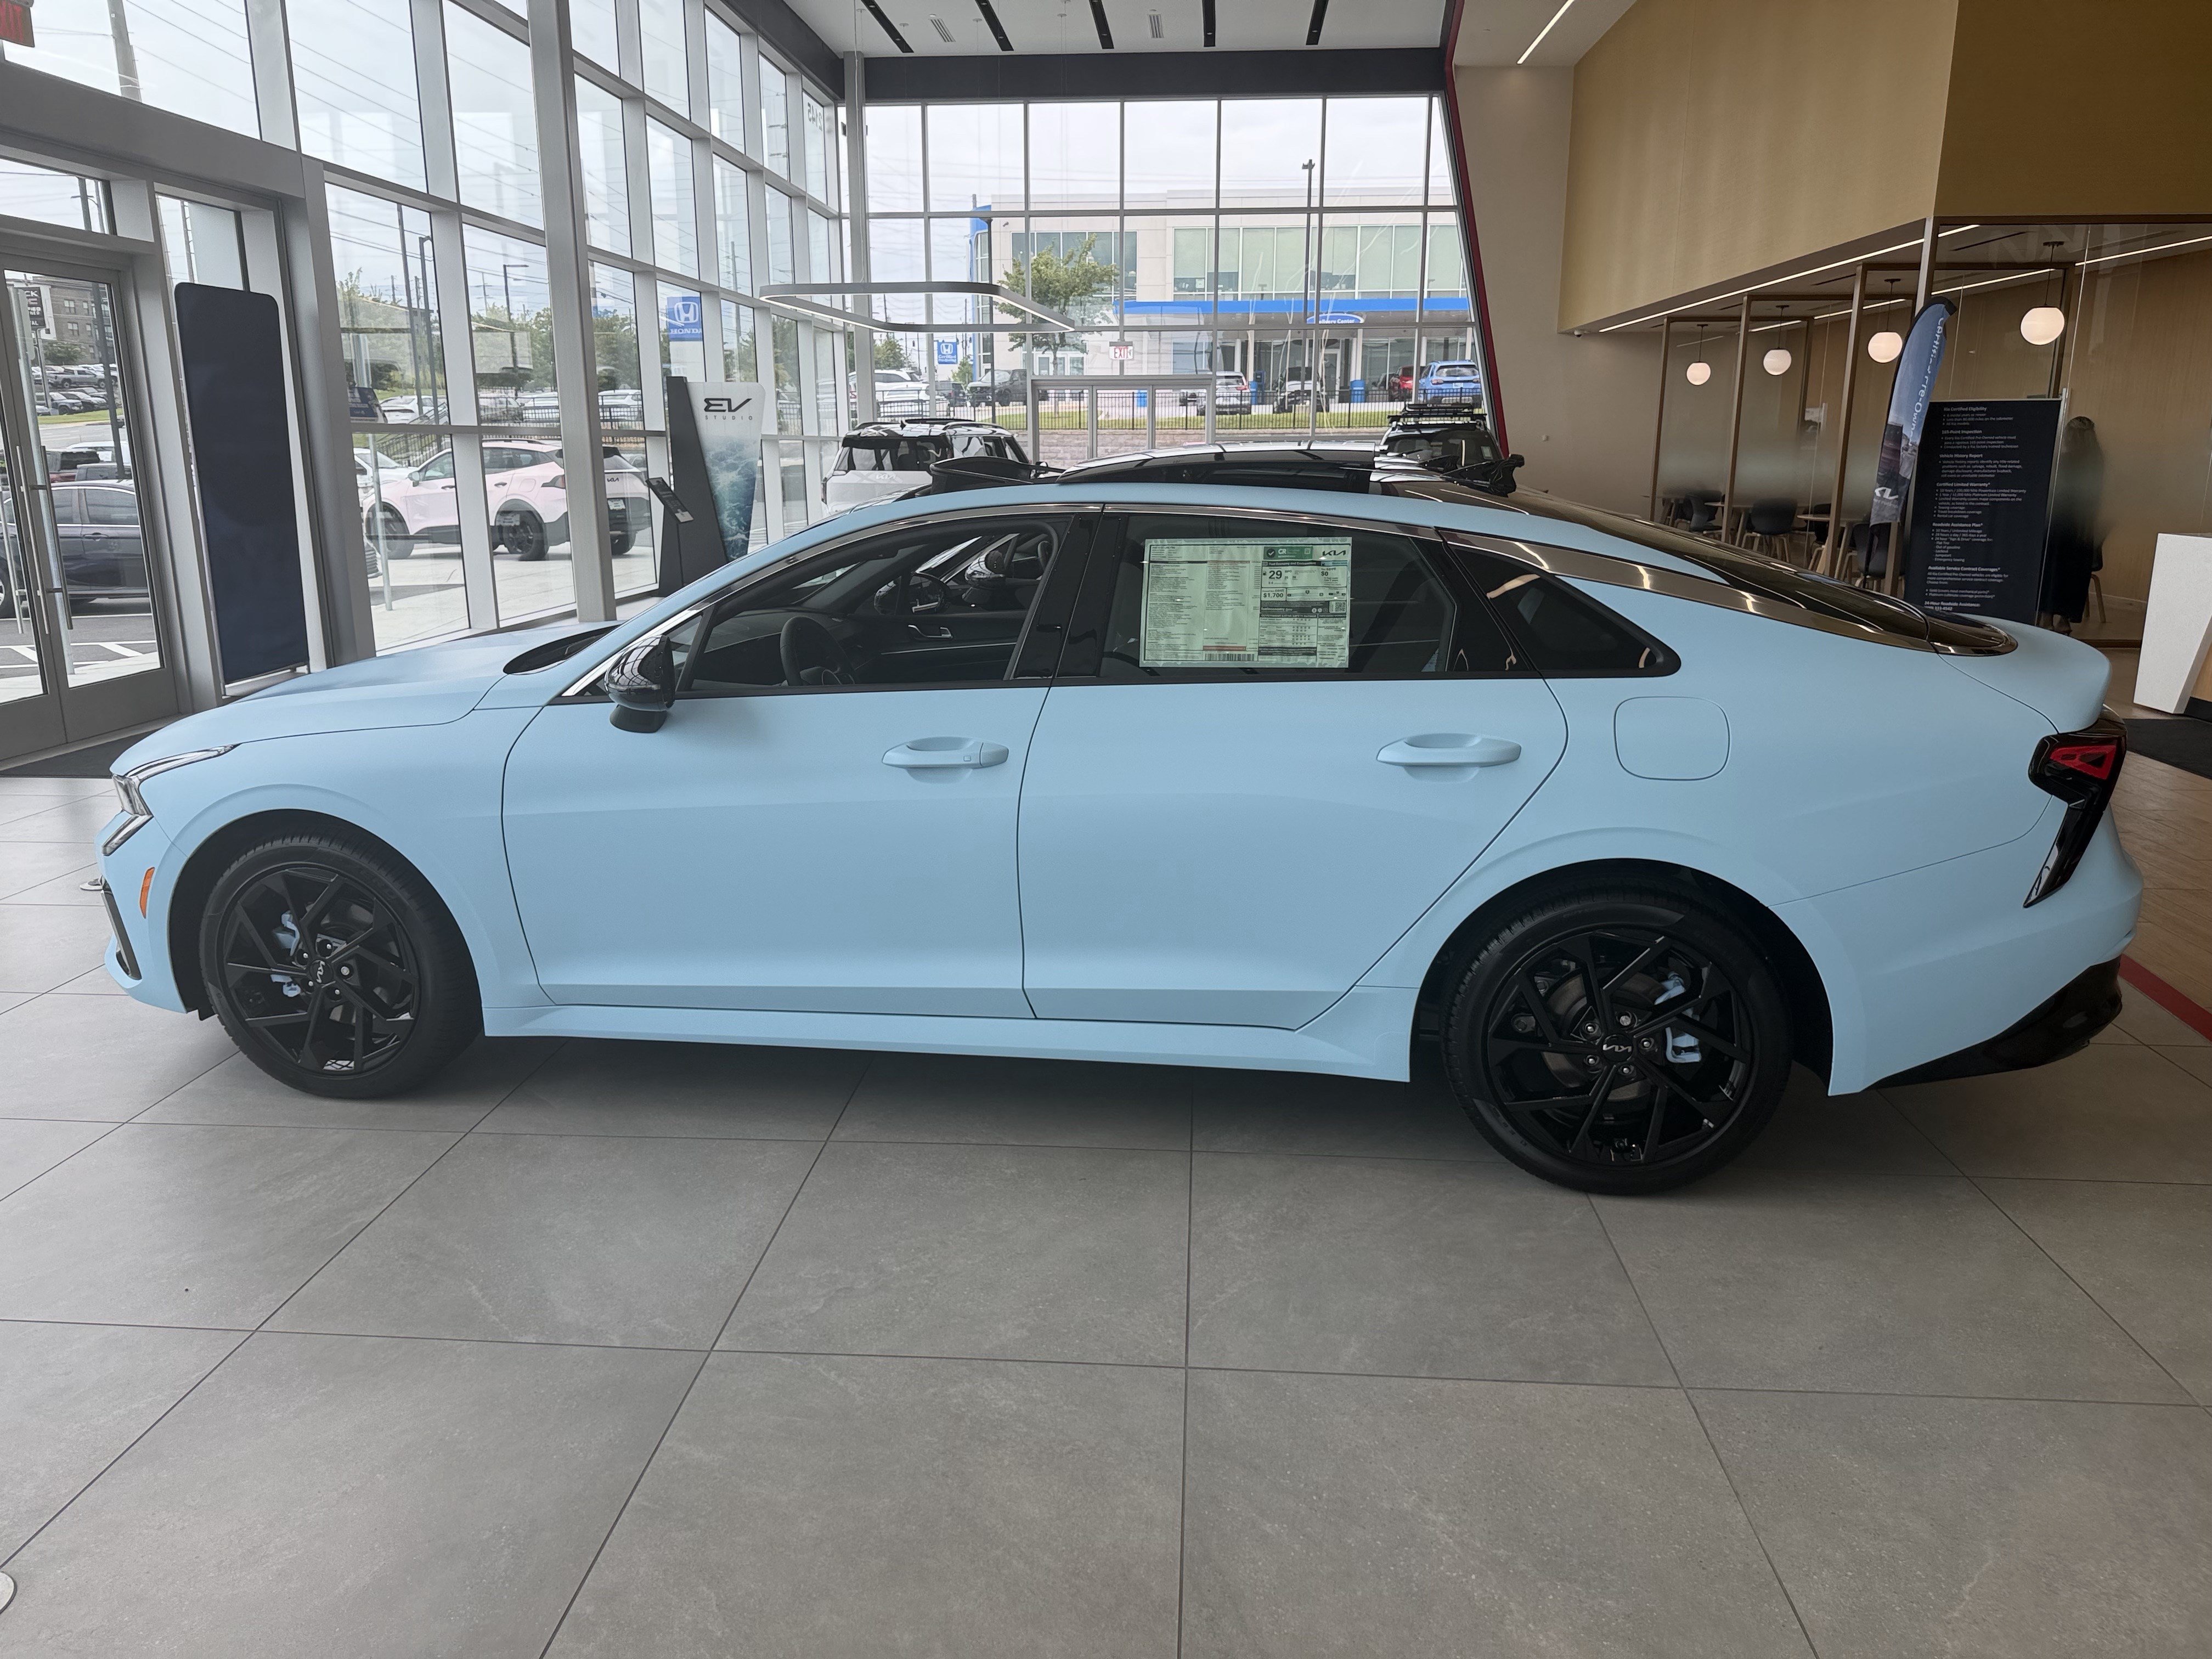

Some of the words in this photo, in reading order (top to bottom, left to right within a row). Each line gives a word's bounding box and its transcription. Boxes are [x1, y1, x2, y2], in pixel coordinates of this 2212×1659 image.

[1114, 347, 1128, 358] EXIT
[704, 398, 752, 412] EV
[1268, 570, 1282, 579] 29
